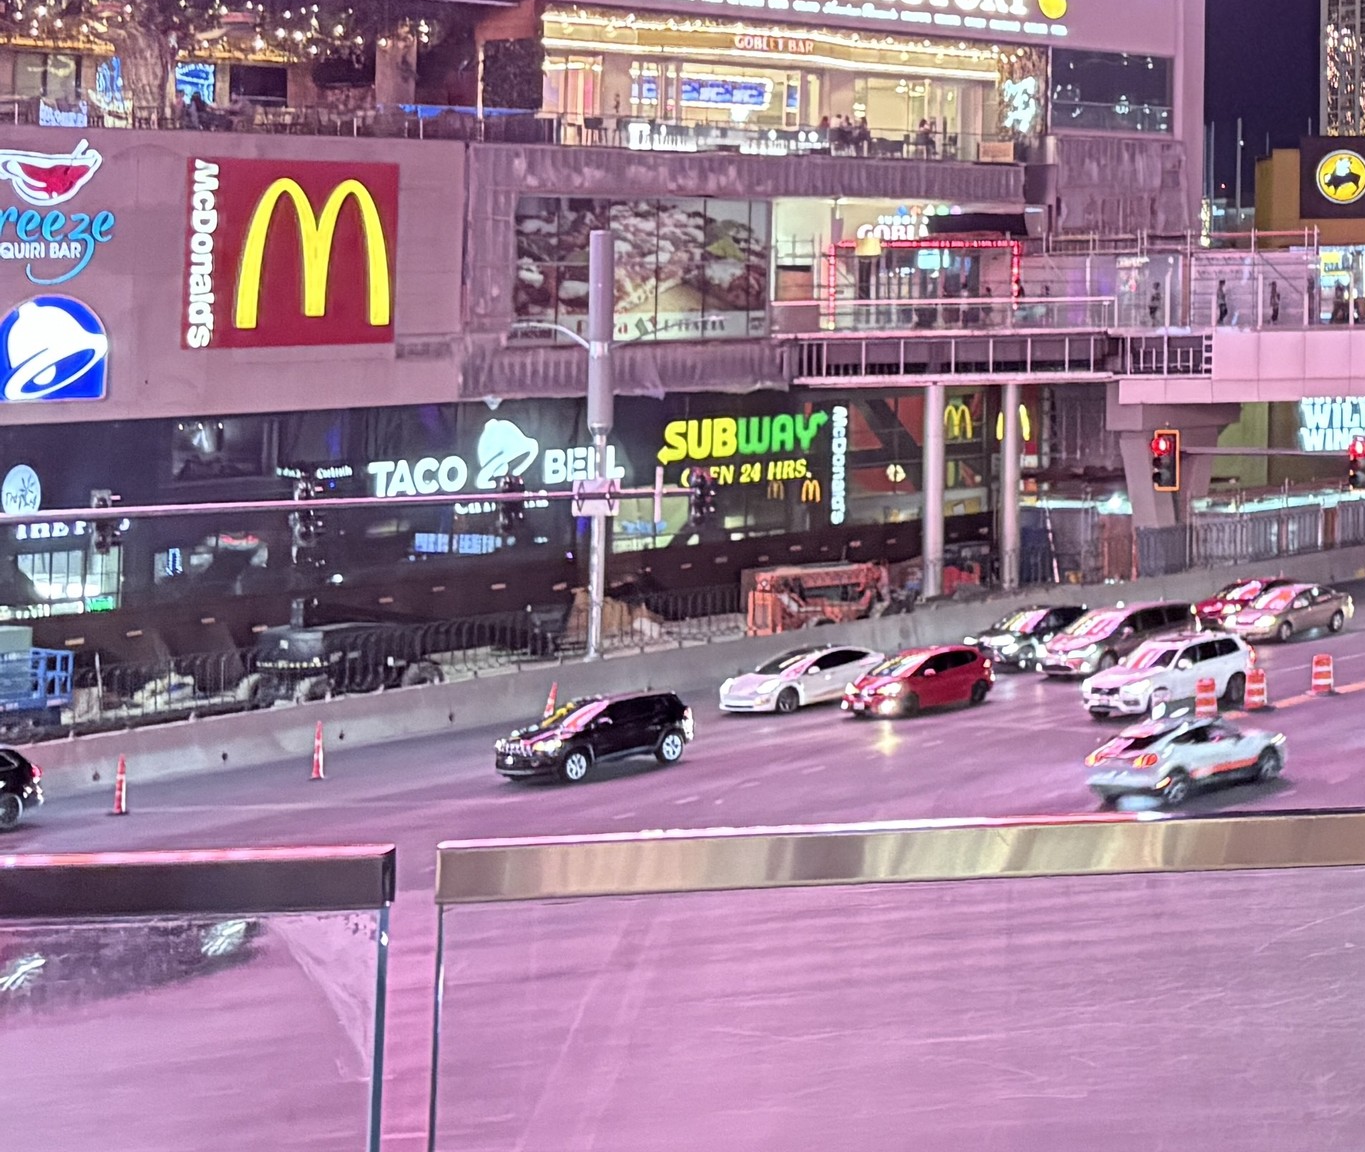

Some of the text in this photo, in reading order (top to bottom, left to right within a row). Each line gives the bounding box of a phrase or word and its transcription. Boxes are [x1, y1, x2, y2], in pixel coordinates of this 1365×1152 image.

[734, 35, 814, 53] GOBLET BAR
[49, 242, 82, 259] BAR
[656, 409, 829, 466] SUBWAY
[367, 455, 468, 498] TACO
[739, 462, 762, 484] 24
[766, 458, 813, 482] HRS.
